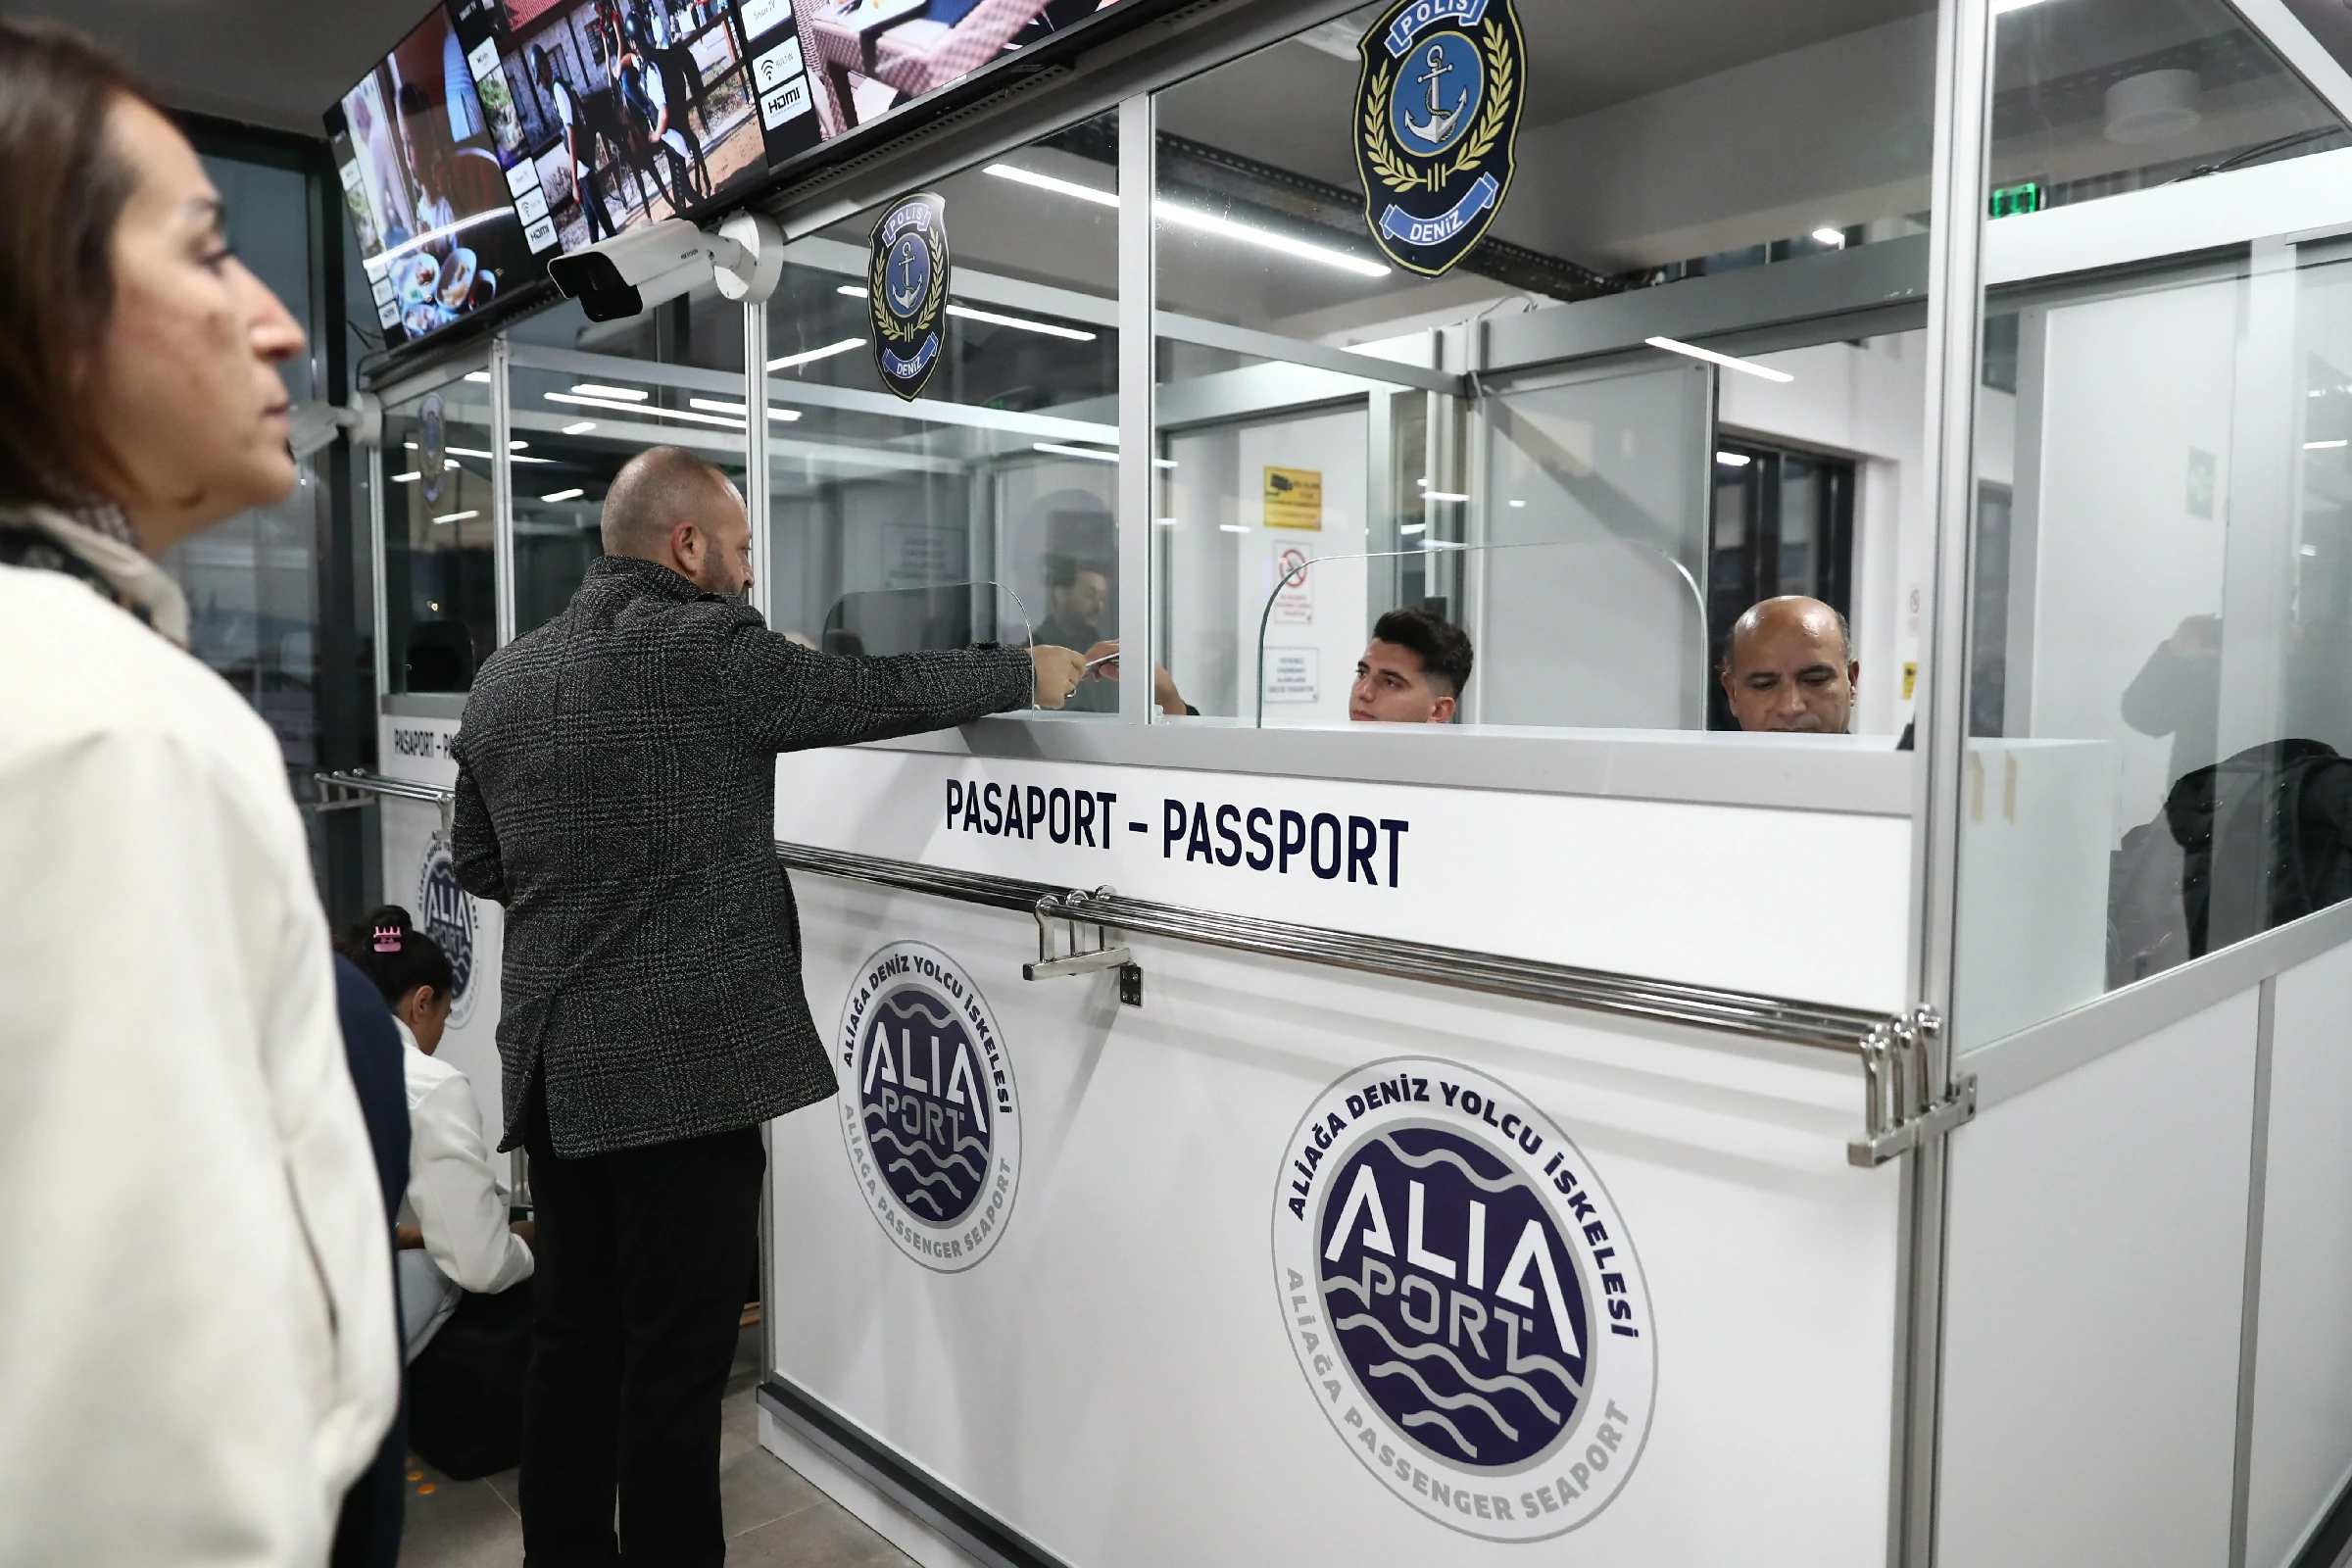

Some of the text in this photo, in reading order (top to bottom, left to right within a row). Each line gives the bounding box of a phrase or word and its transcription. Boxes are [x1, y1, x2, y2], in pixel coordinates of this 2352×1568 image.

[767, 86, 801, 115] HDMI
[529, 223, 551, 242] HDMI
[394, 729, 434, 759] PASAPORT
[946, 778, 1117, 850] PASAPORT
[1163, 798, 1409, 889] PASSPORT
[425, 881, 471, 944] ALIA
[862, 1021, 988, 1134] ALIA
[868, 954, 910, 992] DENİZ
[912, 956, 963, 999] YOLCU
[963, 993, 1012, 1114] İSKELESİ
[881, 1086, 965, 1152] PORT
[877, 1199, 963, 1259] PASSENGER
[964, 1157, 1011, 1250] SEAPORT
[1288, 1073, 1640, 1340] ALİAĞA DENİZ YOLCU İSKELESİ
[1324, 1163, 1582, 1359] ALIA
[1362, 1255, 1533, 1373] PORT
[1287, 1267, 1630, 1521] ALİAĞA PASSENGER SEAPORT
